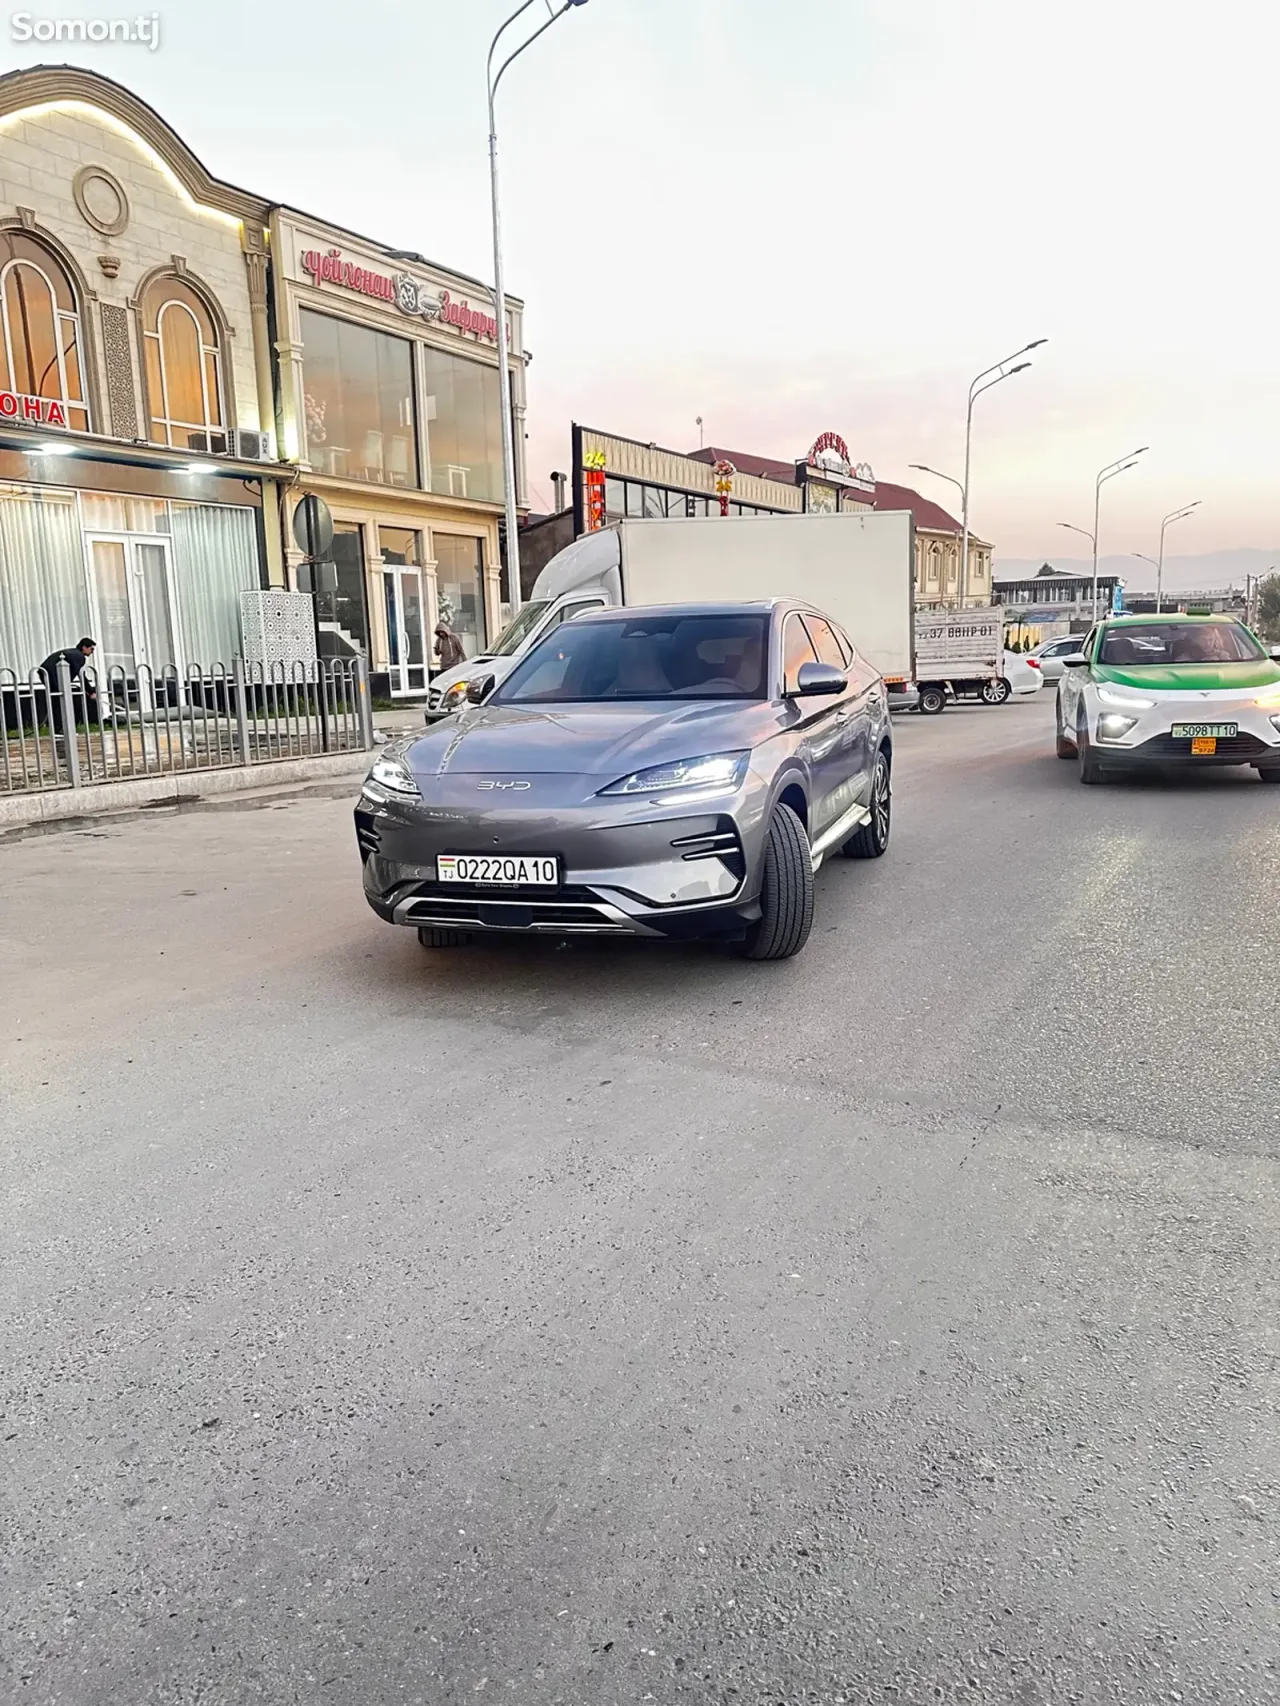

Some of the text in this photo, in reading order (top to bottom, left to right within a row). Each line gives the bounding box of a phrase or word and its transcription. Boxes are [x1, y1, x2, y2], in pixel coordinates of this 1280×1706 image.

[585, 451, 606, 468] 24
[930, 628, 943, 639] 37
[476, 780, 531, 790] BYD
[443, 870, 454, 879] TJ
